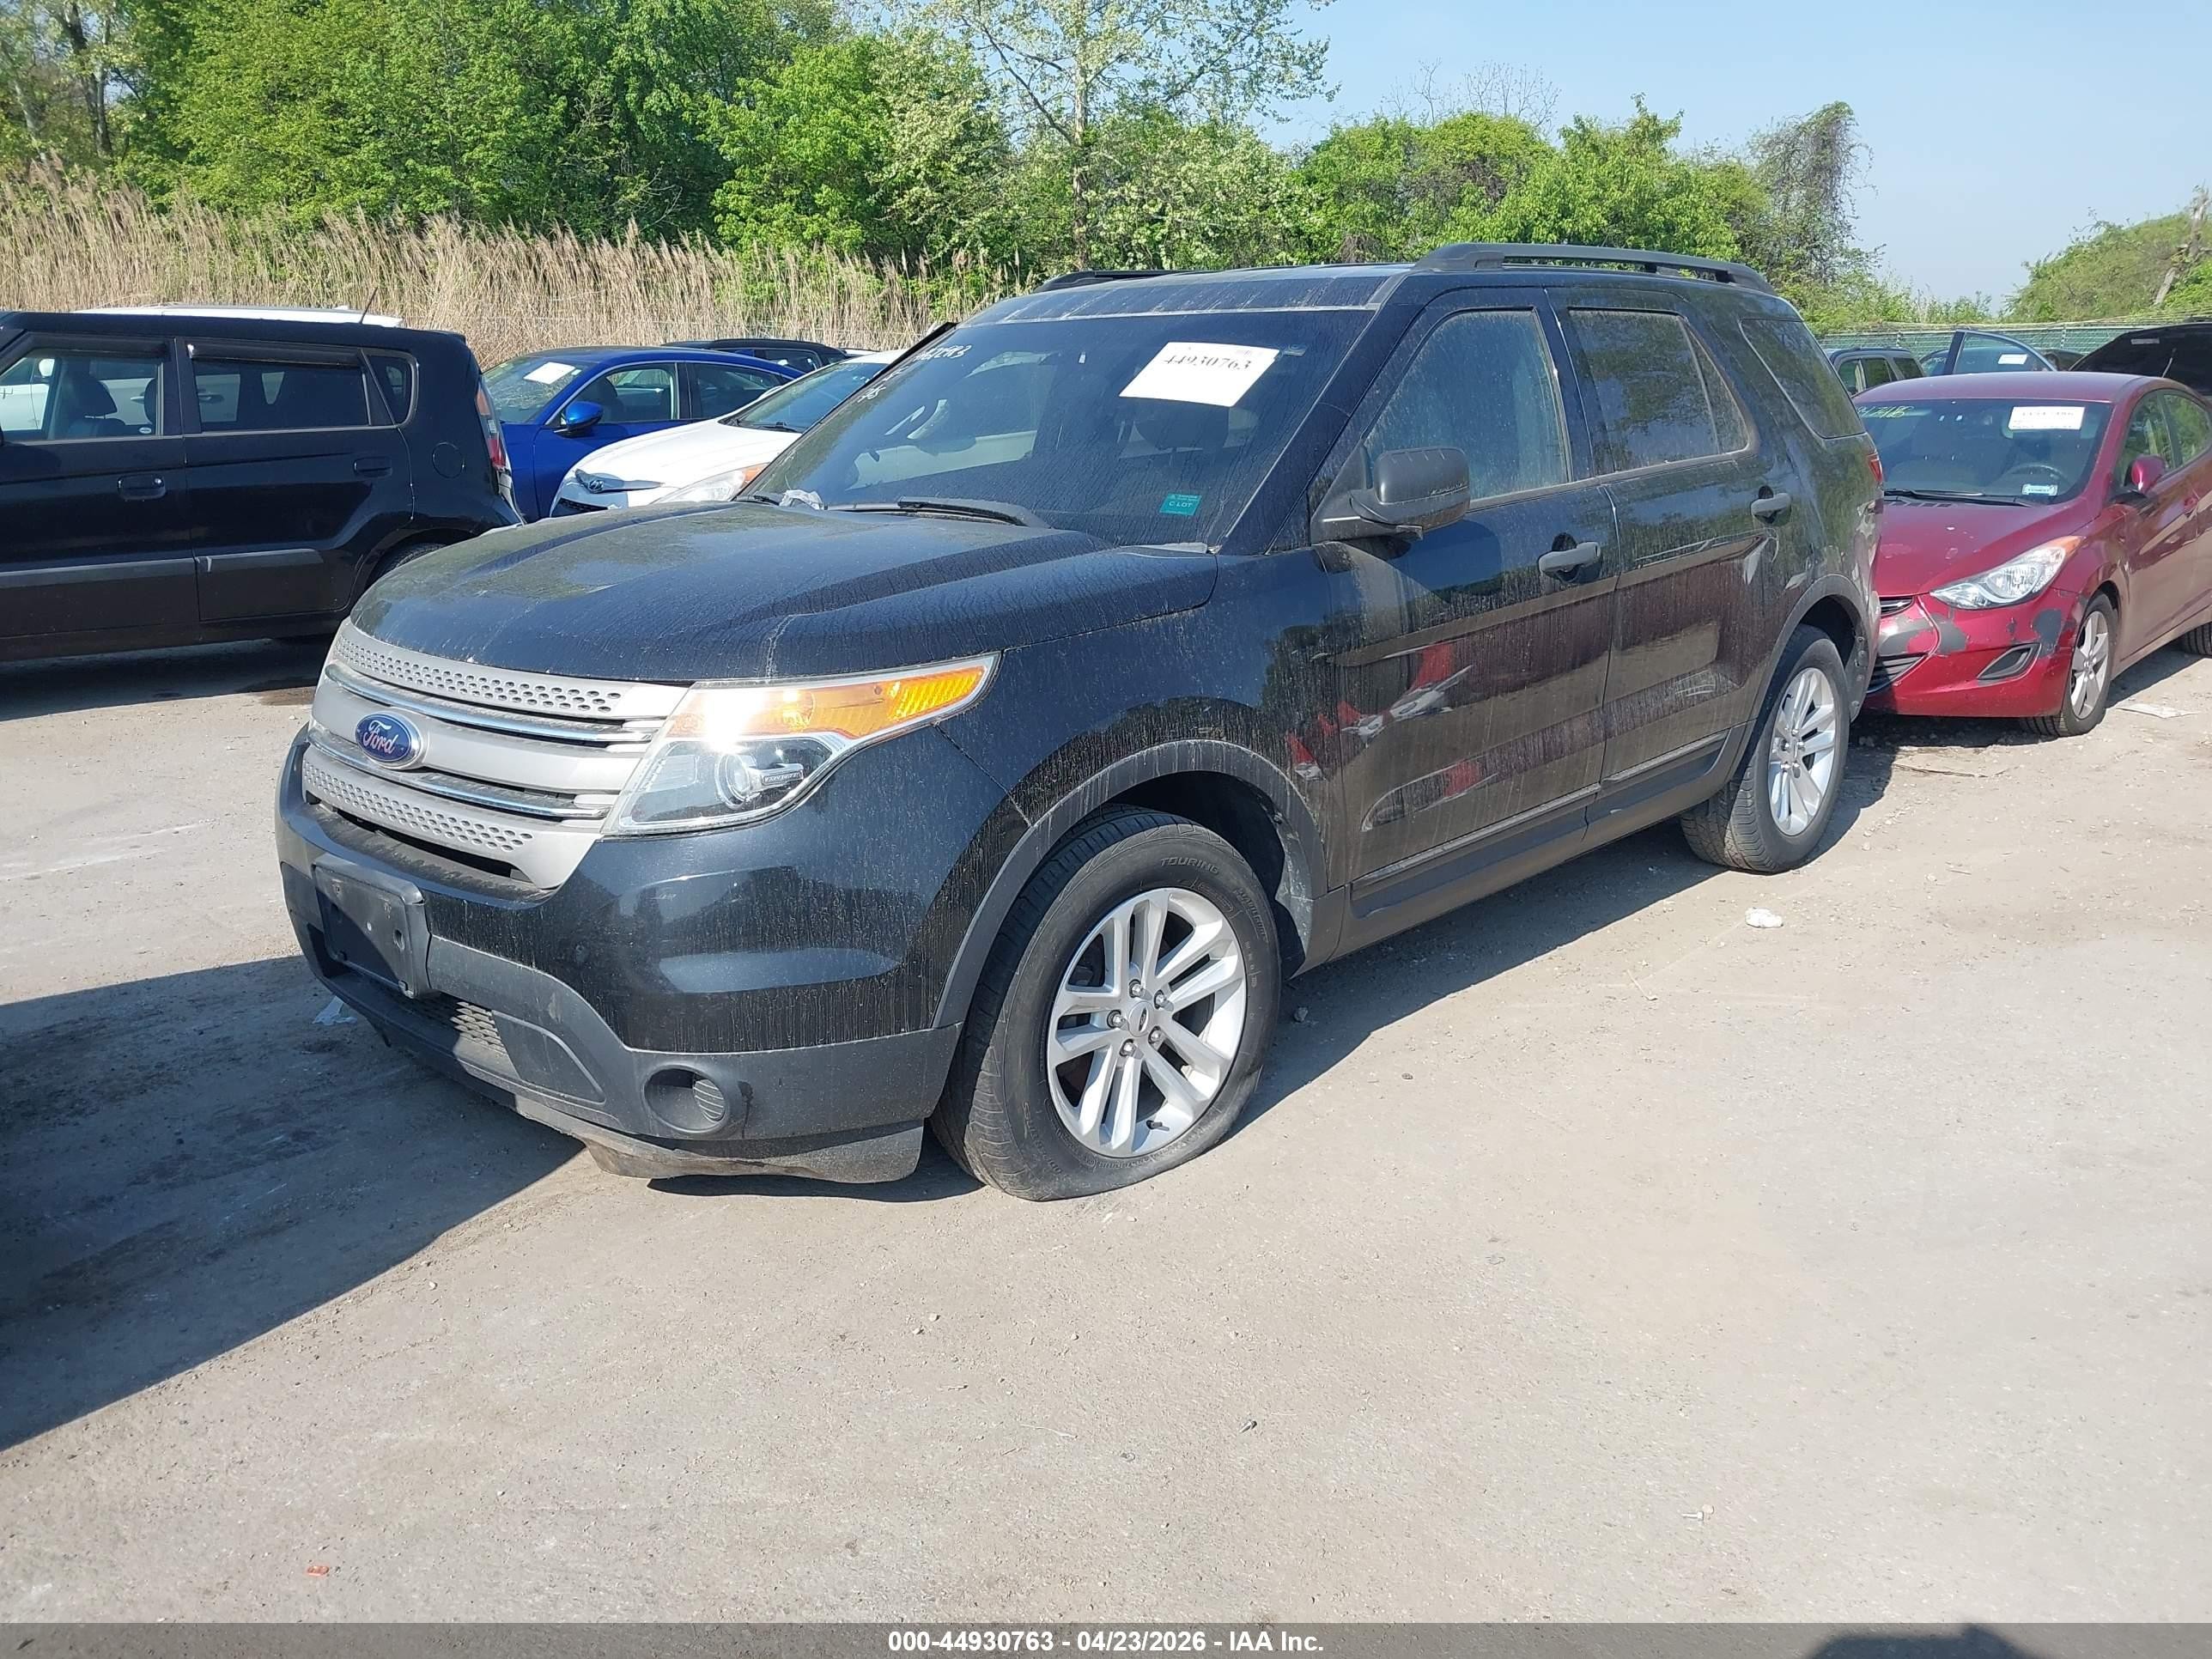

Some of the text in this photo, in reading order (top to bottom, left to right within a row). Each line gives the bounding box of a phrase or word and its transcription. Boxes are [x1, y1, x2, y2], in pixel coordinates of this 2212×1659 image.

[1164, 355, 1251, 370] 44930763
[363, 720, 399, 754] Ford
[1160, 857, 1219, 874] TOURING
